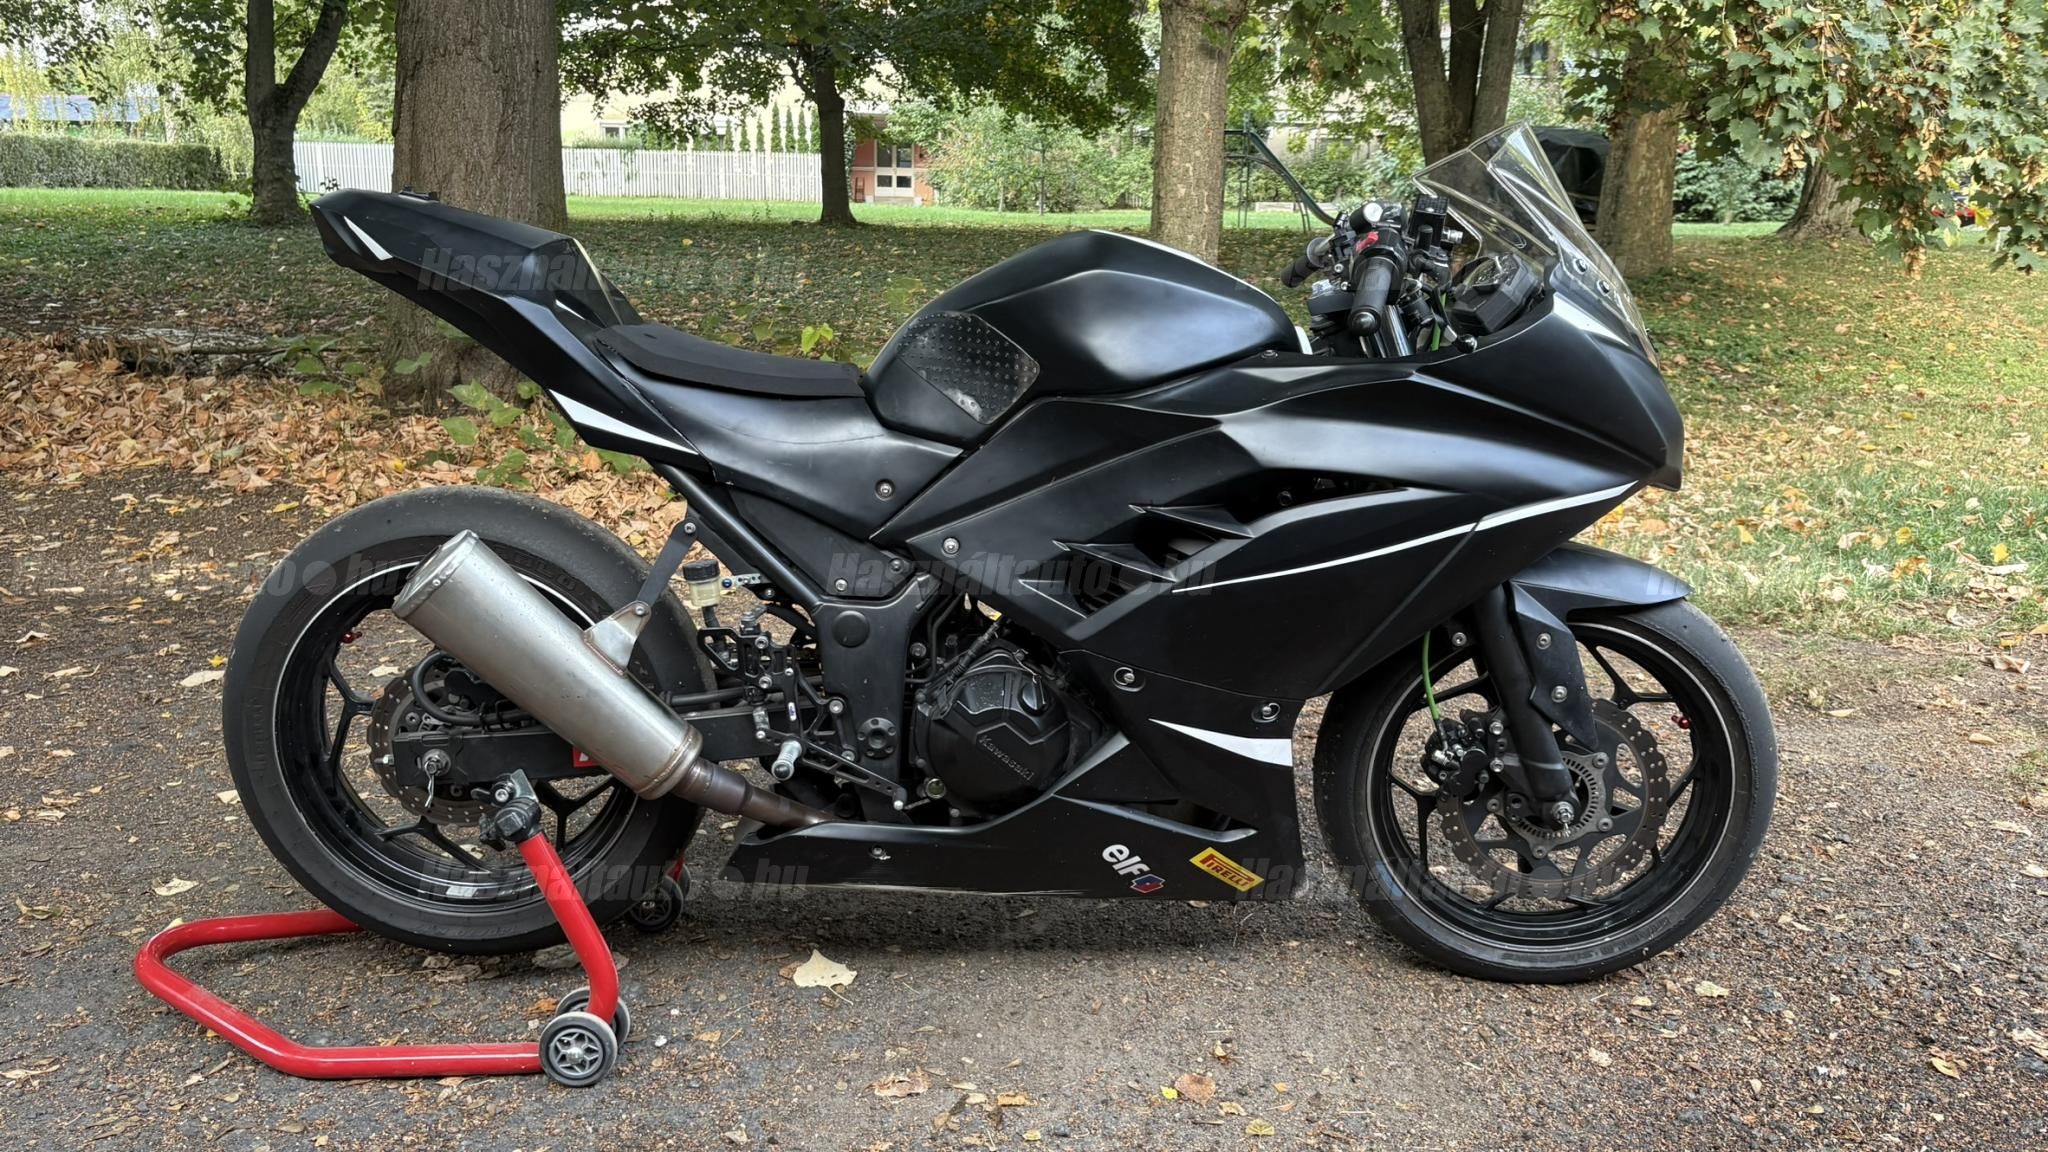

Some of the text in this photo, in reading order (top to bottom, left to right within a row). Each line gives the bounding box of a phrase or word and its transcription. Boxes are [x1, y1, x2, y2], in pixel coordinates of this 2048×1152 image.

[979, 734, 1035, 780] Kawasaki
[1102, 844, 1151, 876] elf
[1200, 853, 1255, 887] PIRELLI
